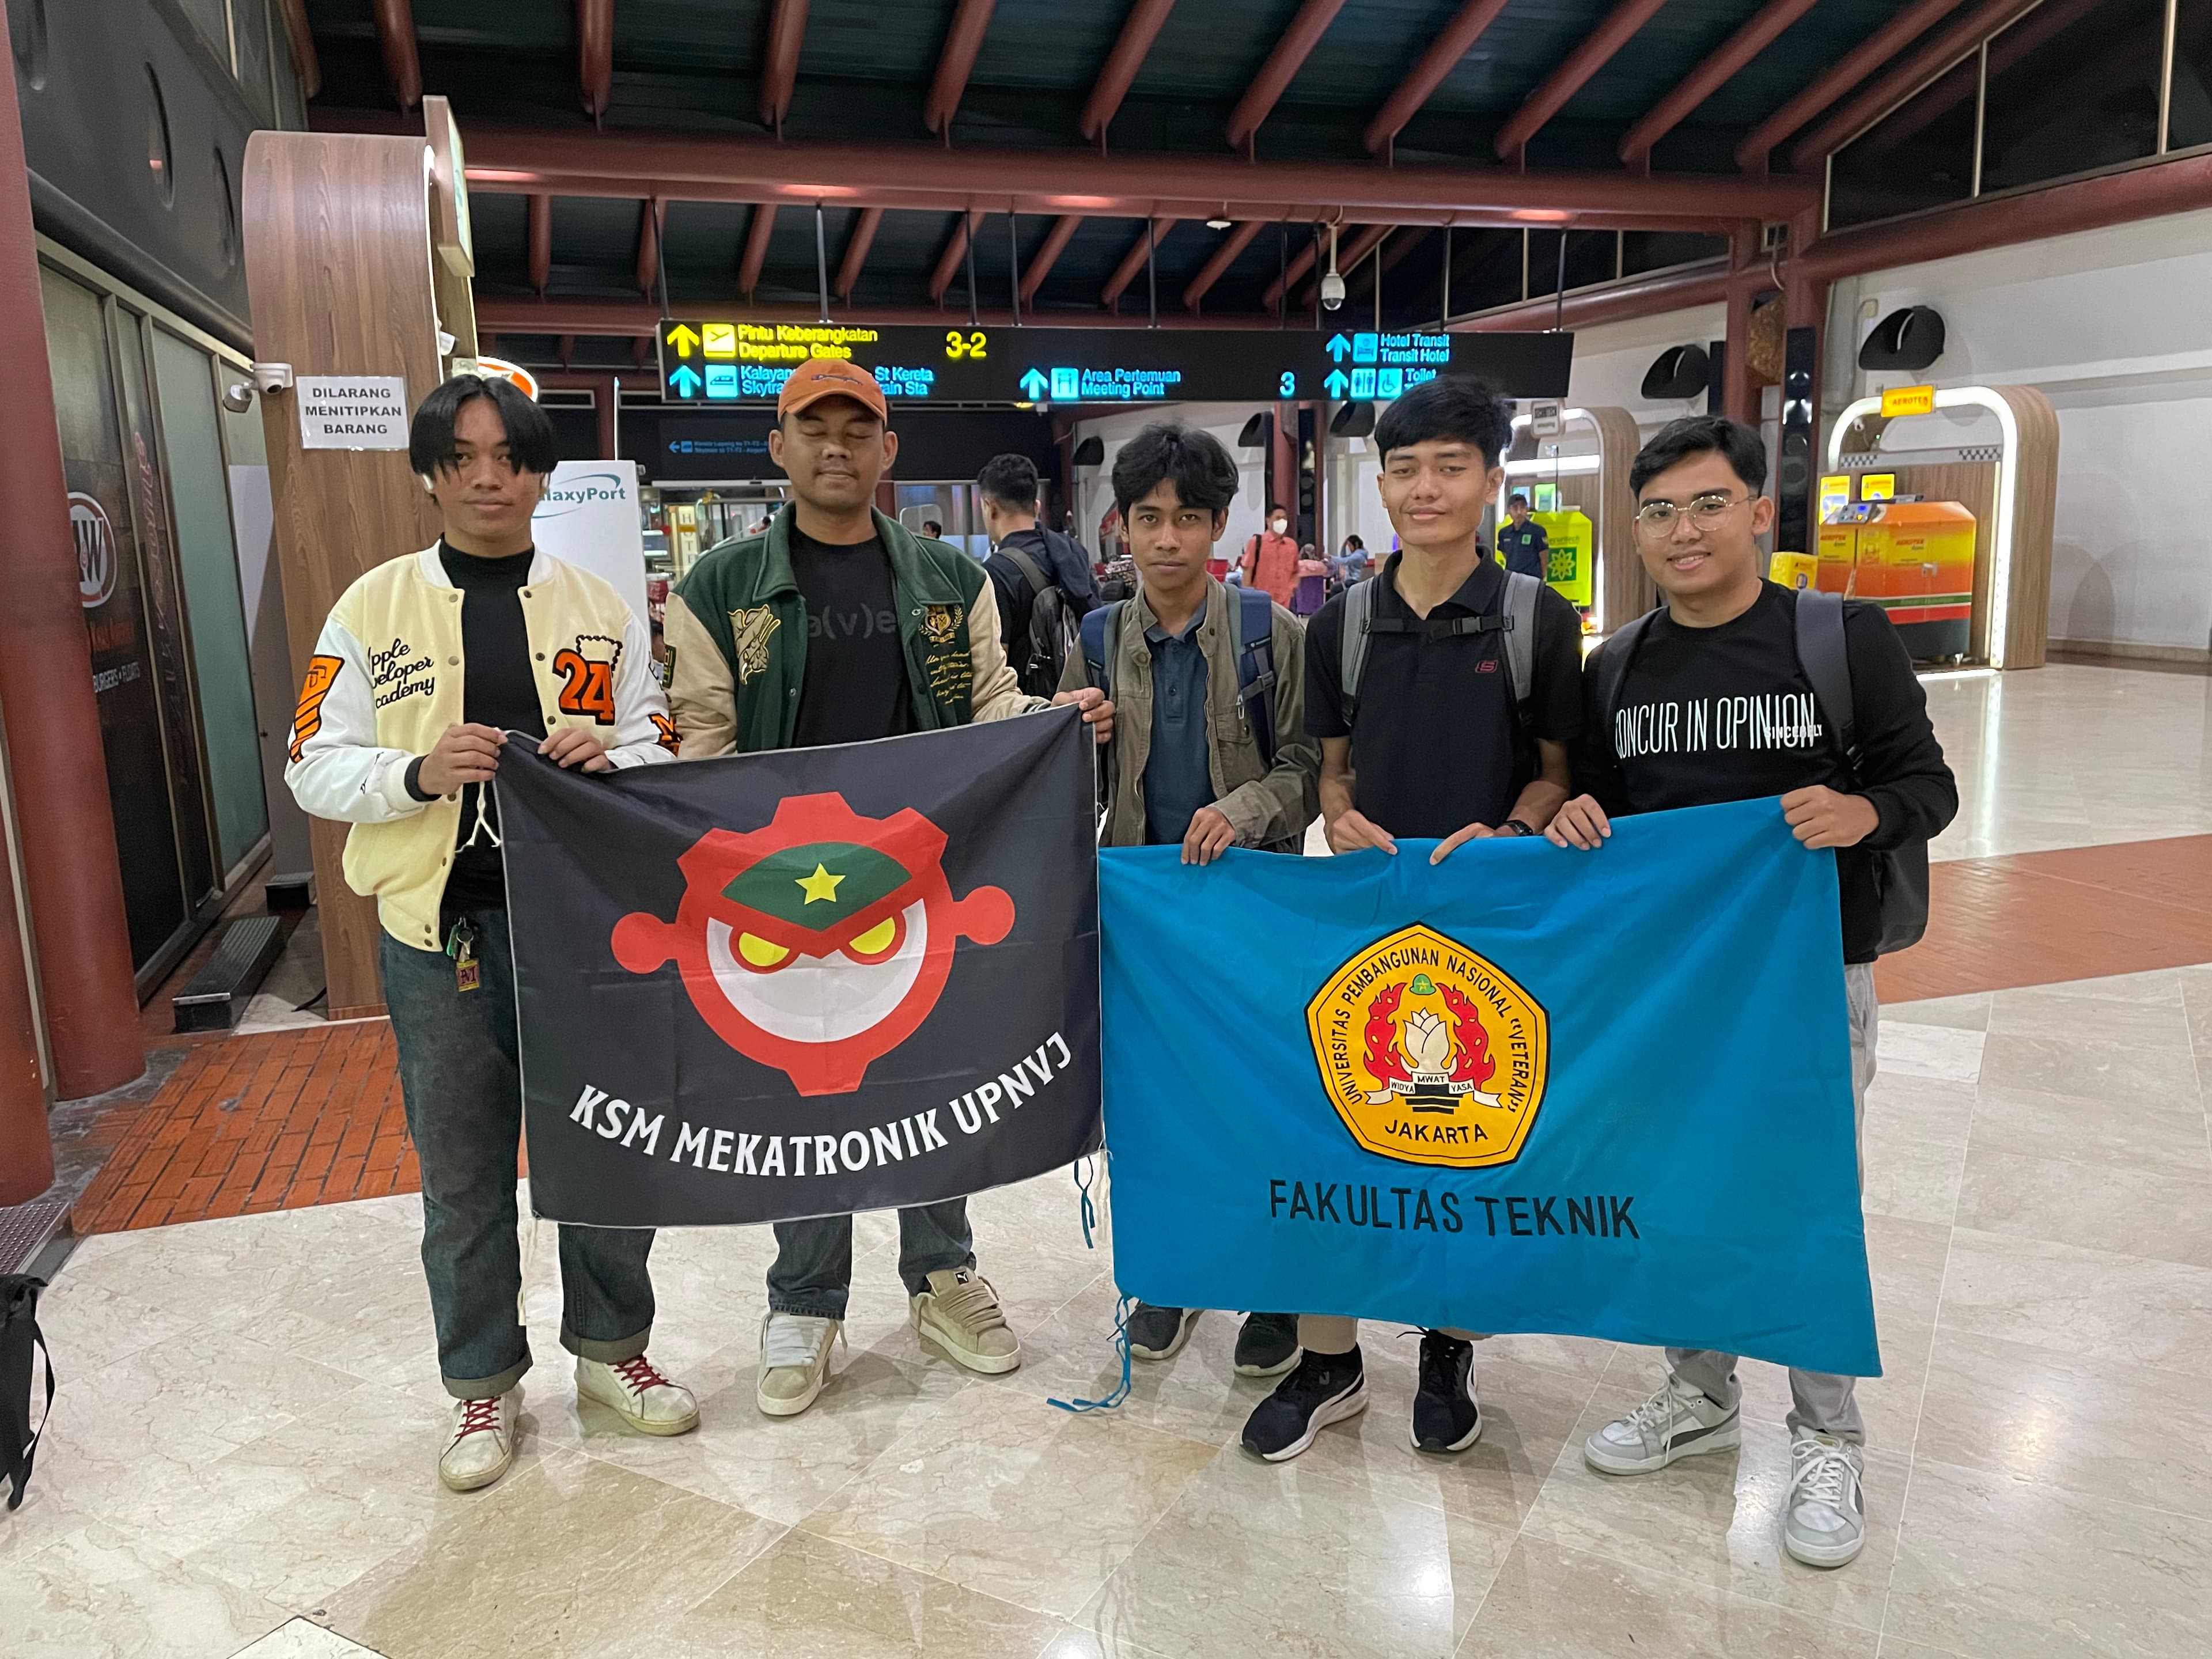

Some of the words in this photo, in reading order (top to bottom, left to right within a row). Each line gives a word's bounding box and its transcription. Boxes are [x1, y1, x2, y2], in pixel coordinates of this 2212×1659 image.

[738, 324, 774, 340] Pintu
[777, 325, 878, 344] Keberangkatan
[1381, 334, 1410, 347] Hotel
[1412, 334, 1449, 347] Transit
[738, 342, 807, 361] Departure
[810, 343, 851, 358] Gates
[945, 332, 987, 357] 3-2
[1380, 349, 1418, 362] Transit
[1420, 349, 1449, 362] Hotel
[741, 366, 795, 382] Kalayan
[875, 366, 889, 381] St
[892, 368, 933, 381] Kereta
[1082, 369, 1112, 381] Area
[1115, 368, 1181, 382] Pertemuan
[312, 388, 392, 398] DILARANG
[742, 380, 784, 397] Skytra
[905, 381, 927, 395] Sta
[1081, 381, 1130, 398] Meeting
[1133, 381, 1165, 395] Point
[1279, 372, 1295, 396] 3
[305, 406, 402, 416] MENITIPKAN
[324, 424, 388, 434] BARANG
[542, 488, 626, 503] laxyPort
[552, 649, 615, 725] 24
[1687, 698, 1708, 752] IN
[1717, 692, 1815, 749] OPINION
[1342, 947, 1439, 1005] PEMBANGUNAN
[1446, 955, 1513, 1018] NASIONAL
[1331, 1008, 1363, 1105] UNIVERSITAS
[1391, 1081, 1414, 1093] WIDYA
[1451, 1083, 1473, 1092] YASA
[569, 1084, 665, 1156] KSM
[669, 1108, 949, 1177] MEKATRONIK
[948, 1032, 1072, 1136] UPNVJ
[1384, 1119, 1488, 1144] JAKARTA
[1270, 1179, 1463, 1233] FAKULTAS
[1475, 1195, 1641, 1240] TEKNIK
